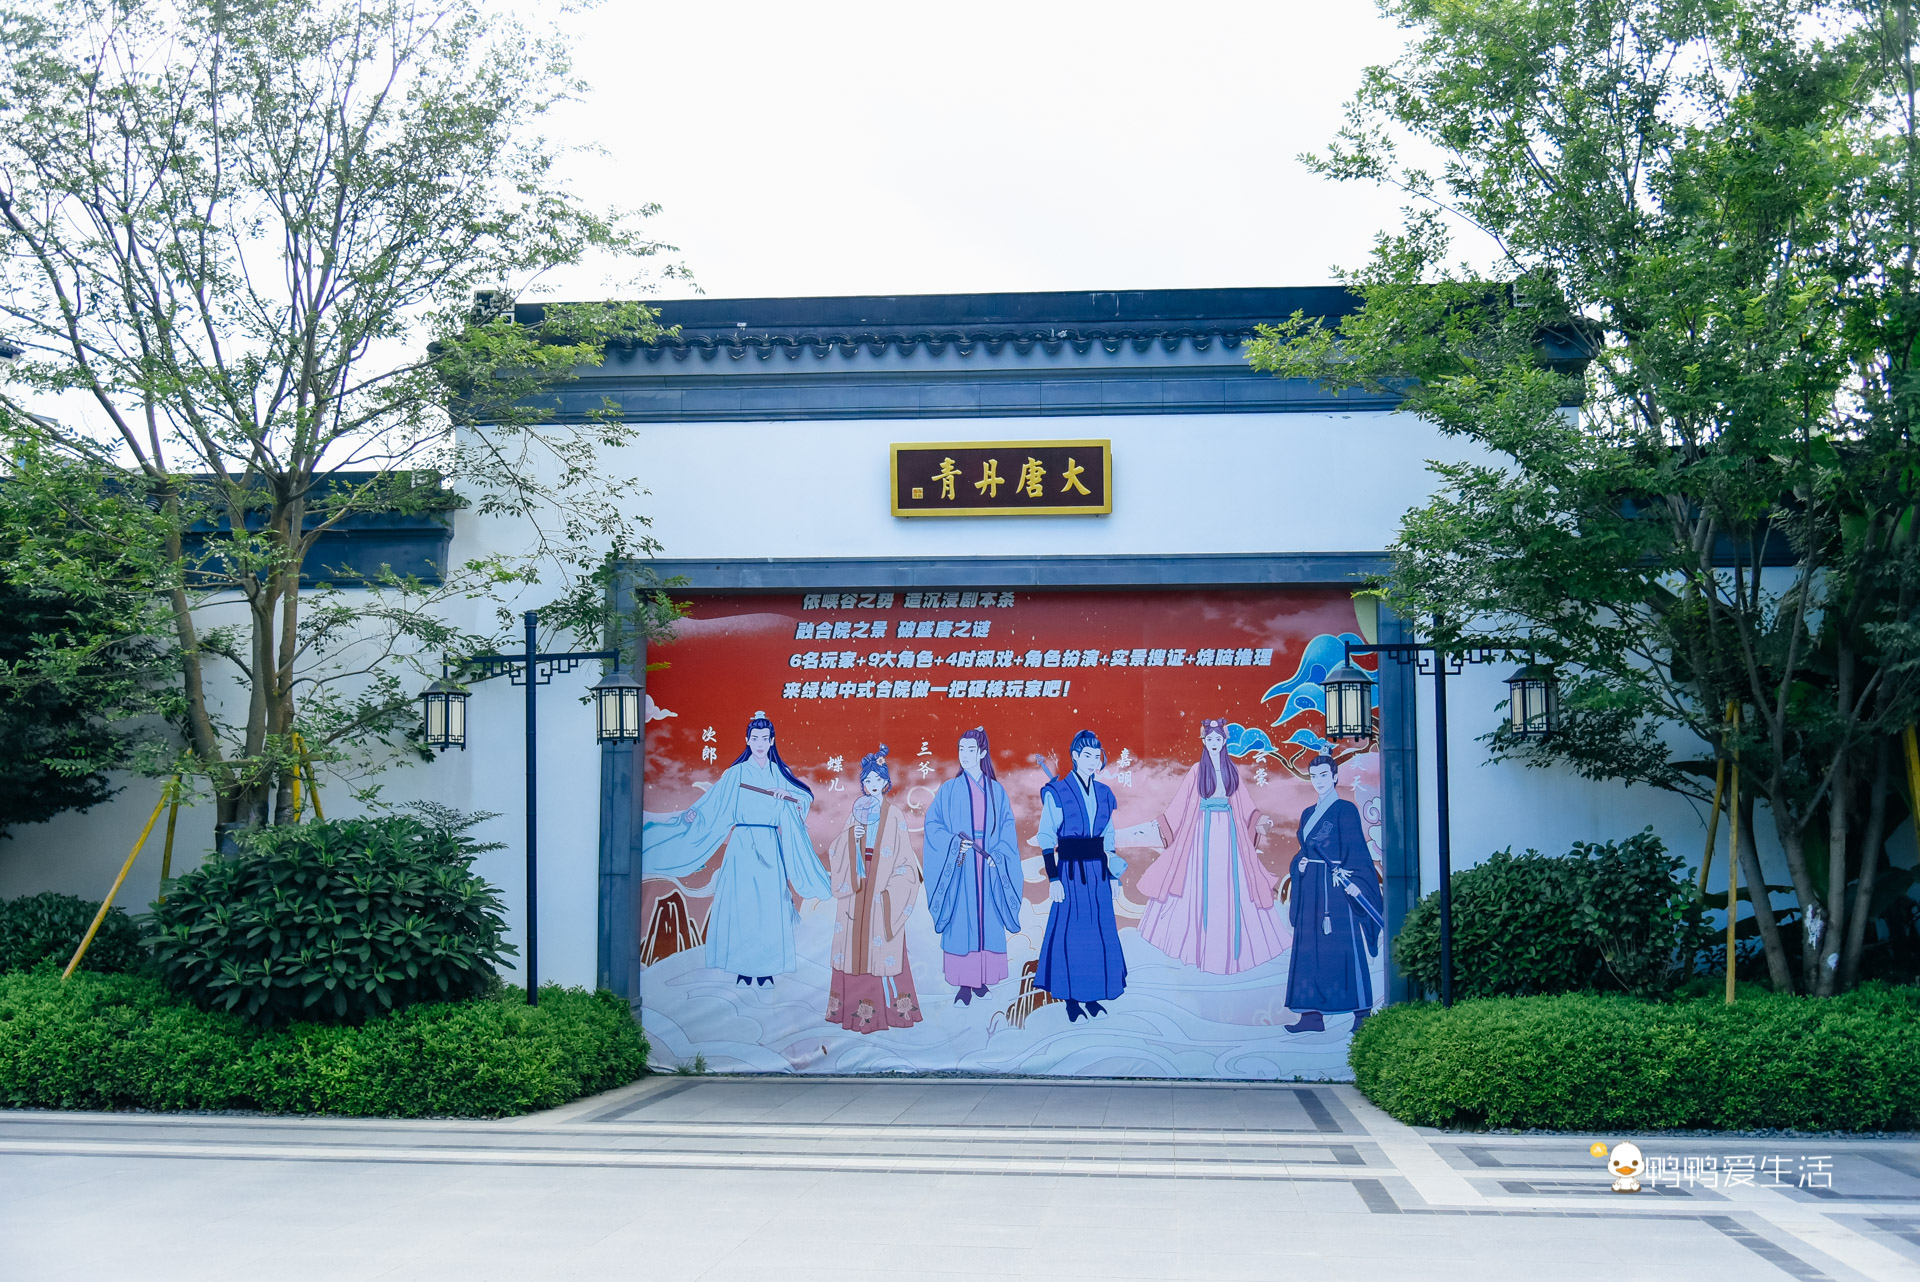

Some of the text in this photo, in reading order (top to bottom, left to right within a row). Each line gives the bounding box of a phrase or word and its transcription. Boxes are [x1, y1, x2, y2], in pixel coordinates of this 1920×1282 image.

[795, 620, 992, 640] 融合院之景 破盛唐之谜
[701, 725, 718, 765] 次郎
[916, 740, 936, 780] 三爷
[826, 754, 845, 792] 蝶儿
[1116, 747, 1133, 788] 嘉明
